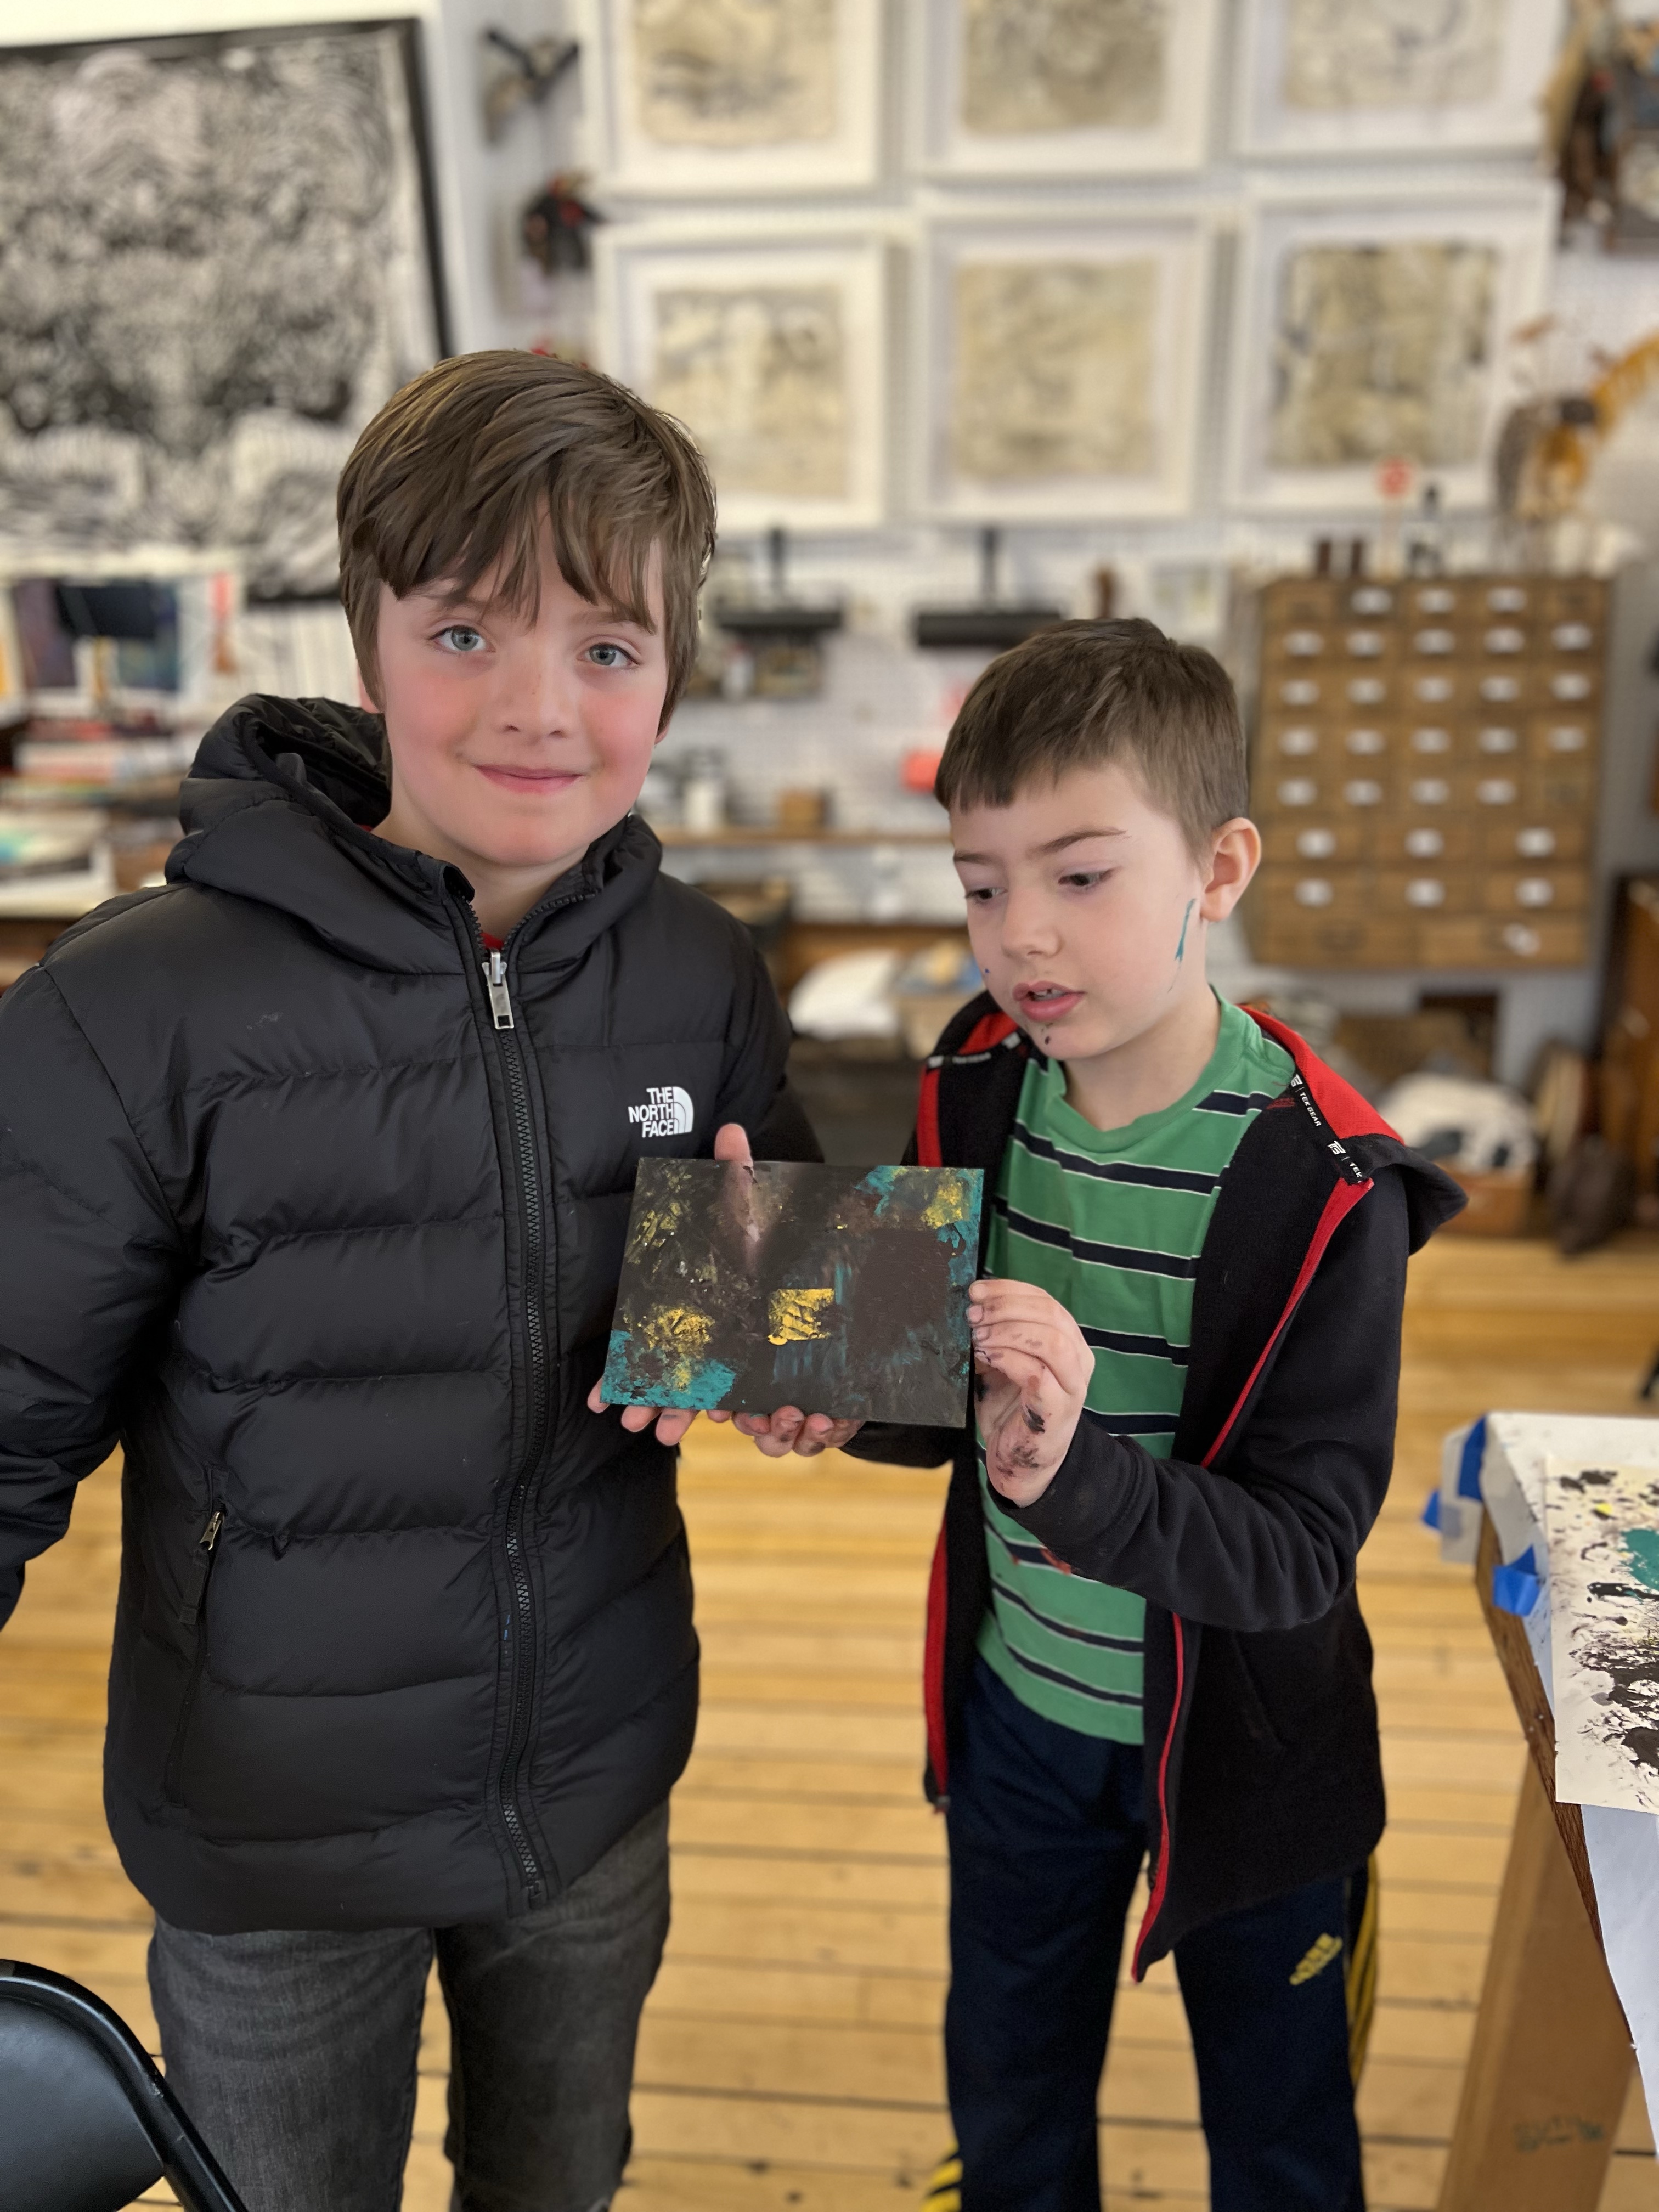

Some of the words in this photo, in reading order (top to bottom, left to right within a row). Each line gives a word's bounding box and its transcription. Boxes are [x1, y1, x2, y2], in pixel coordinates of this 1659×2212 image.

[646, 1087, 674, 1104] THE
[628, 1103, 674, 1123] NORTH
[1300, 1092, 1311, 1107] TEK
[1307, 1107, 1322, 1126] GEAR
[641, 1119, 674, 1138] FACE
[1350, 1162, 1363, 1178] TEK
